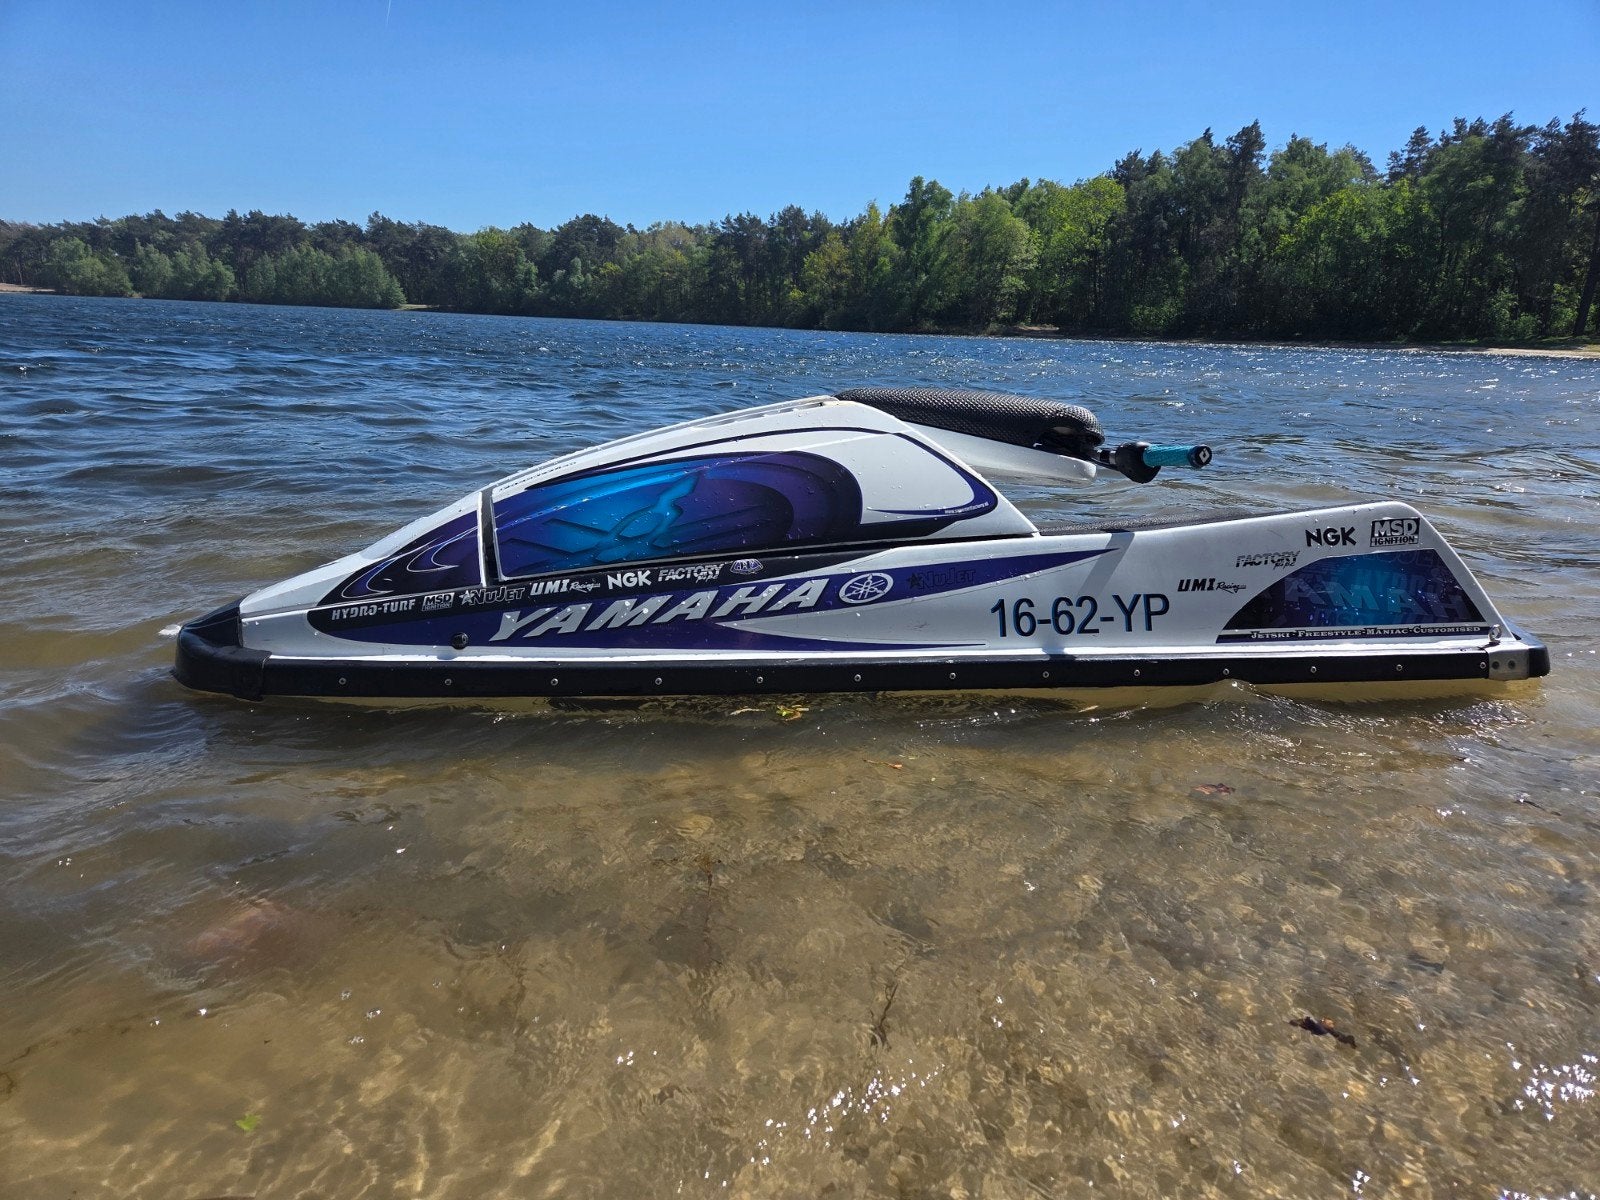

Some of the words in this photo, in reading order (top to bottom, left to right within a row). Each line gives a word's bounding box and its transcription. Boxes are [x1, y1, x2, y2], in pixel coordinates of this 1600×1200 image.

[1305, 527, 1357, 547] NGK
[1374, 520, 1417, 537] MSD
[1374, 535, 1415, 546] IGNITION
[1235, 550, 1300, 567] FACTORY
[607, 570, 652, 590] NGK
[658, 563, 725, 582] FACTORY
[530, 579, 570, 596] UMI
[1177, 578, 1216, 592] UMI
[425, 593, 453, 606] MSD
[331, 599, 416, 621] HYDRO-TURF
[489, 578, 830, 642] YAMAHA
[990, 593, 1170, 637] 16-62-YP
